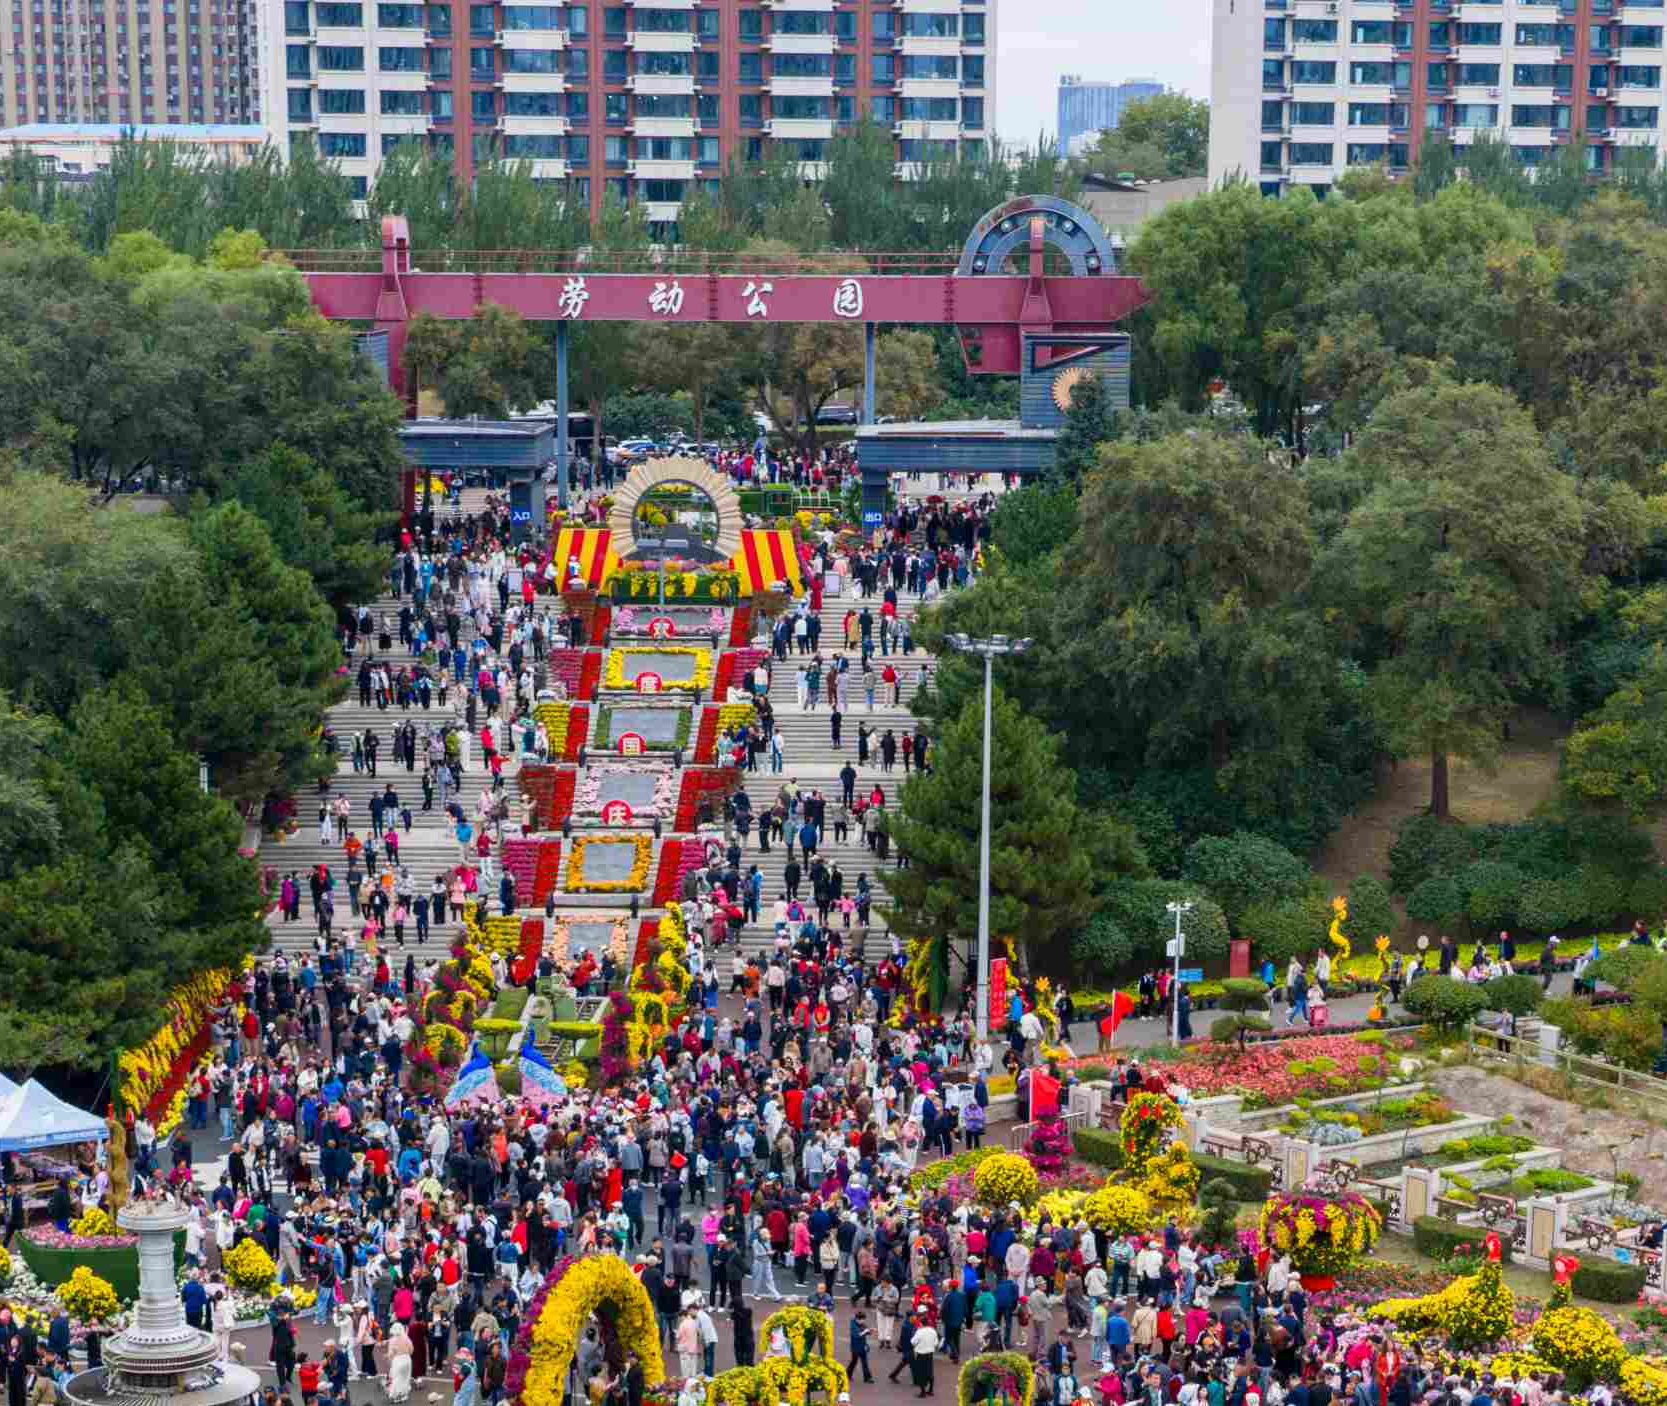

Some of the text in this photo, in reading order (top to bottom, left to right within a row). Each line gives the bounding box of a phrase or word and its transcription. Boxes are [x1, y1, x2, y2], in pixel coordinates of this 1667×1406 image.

[558, 277, 863, 319] 劳动公园
[512, 511, 531, 521] 入口
[864, 511, 882, 522] 出口
